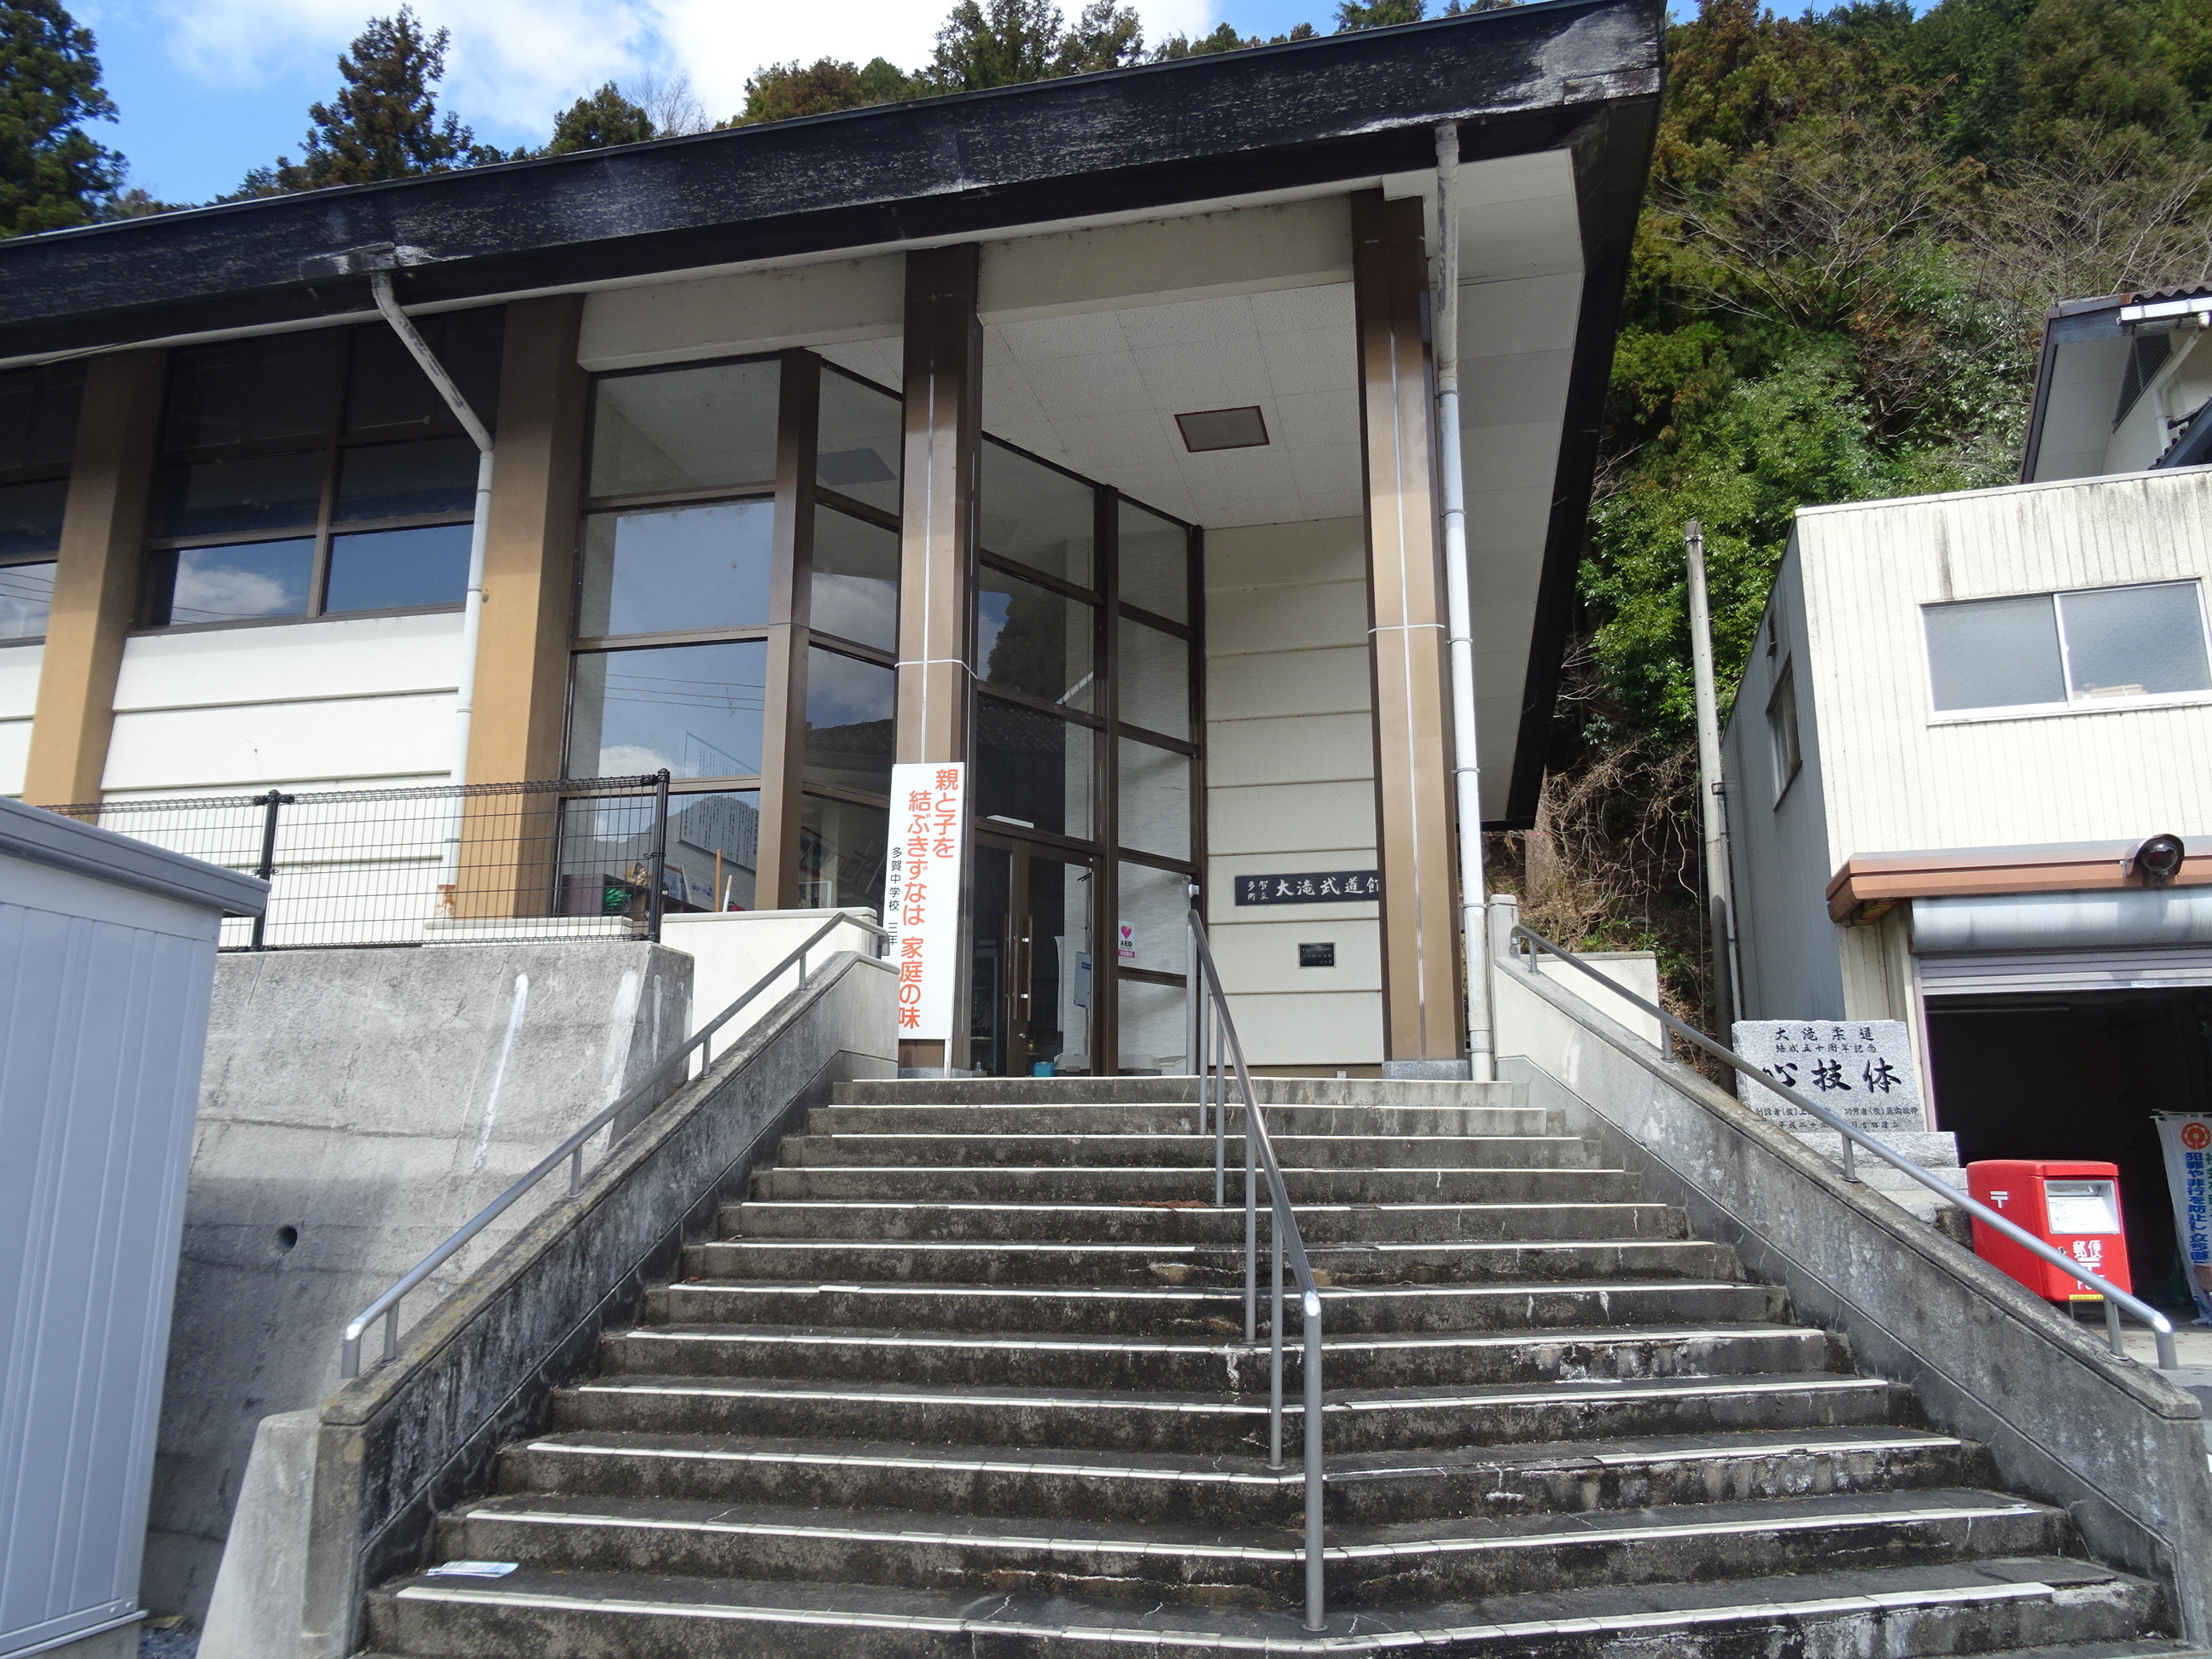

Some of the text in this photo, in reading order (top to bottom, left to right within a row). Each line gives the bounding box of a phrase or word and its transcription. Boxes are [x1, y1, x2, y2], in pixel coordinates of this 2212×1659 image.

[932, 769, 958, 859] 親と子を
[888, 847, 902, 911] 多賀中学校
[899, 790, 932, 1029] 結ぶきずなは 家庭の味
[1775, 1027, 1875, 1041] 大滝柔道
[1761, 1057, 1902, 1094] 心技体
[2072, 1239, 2103, 1259] 郵便
